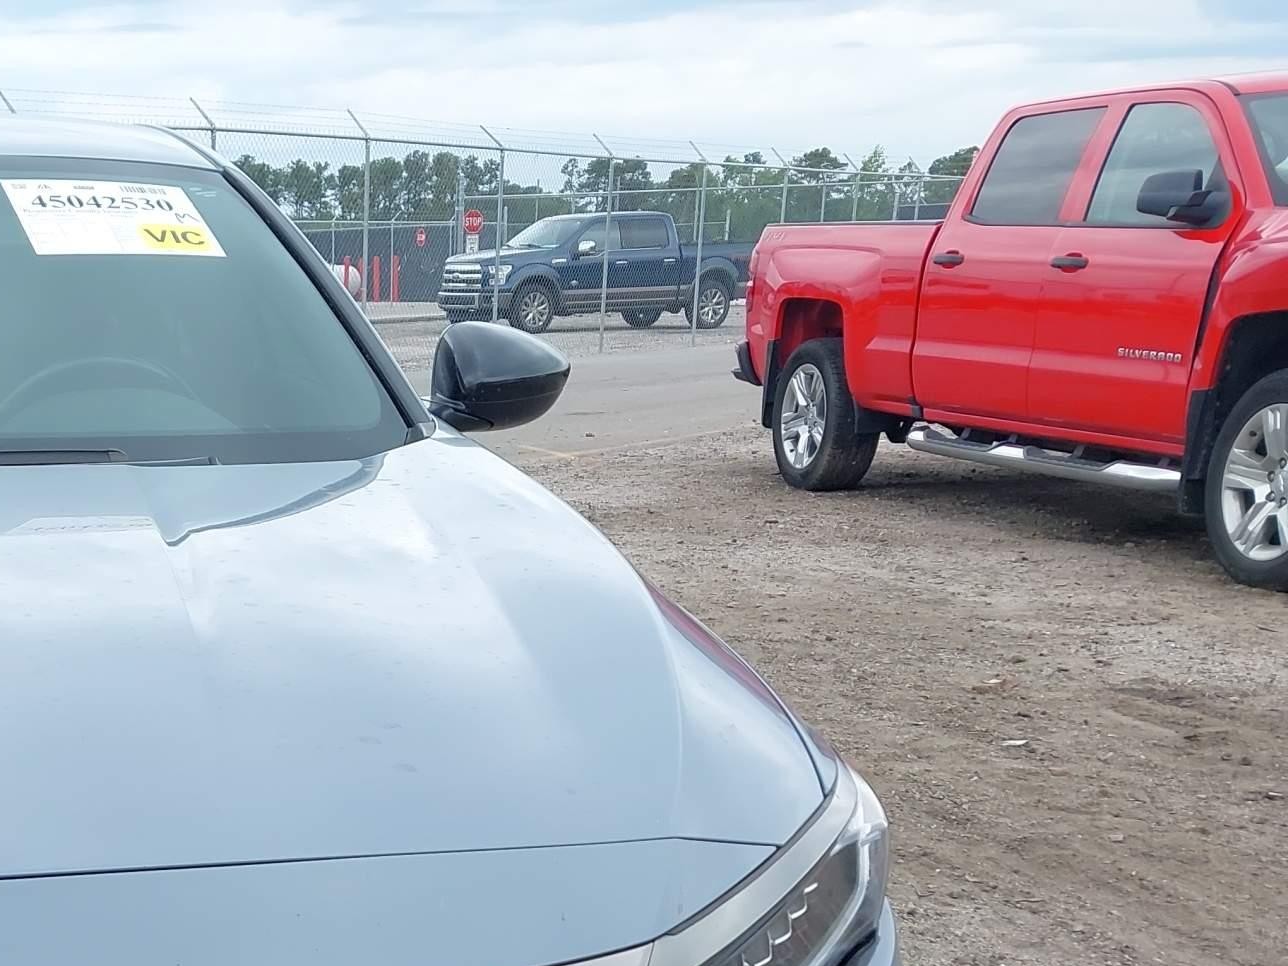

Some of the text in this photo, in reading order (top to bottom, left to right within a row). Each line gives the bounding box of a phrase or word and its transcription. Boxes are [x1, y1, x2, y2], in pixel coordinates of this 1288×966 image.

[31, 194, 173, 212] 45042530
[465, 217, 482, 227] STOP
[143, 229, 205, 245] VIC
[1117, 347, 1183, 363] SILVERADO
